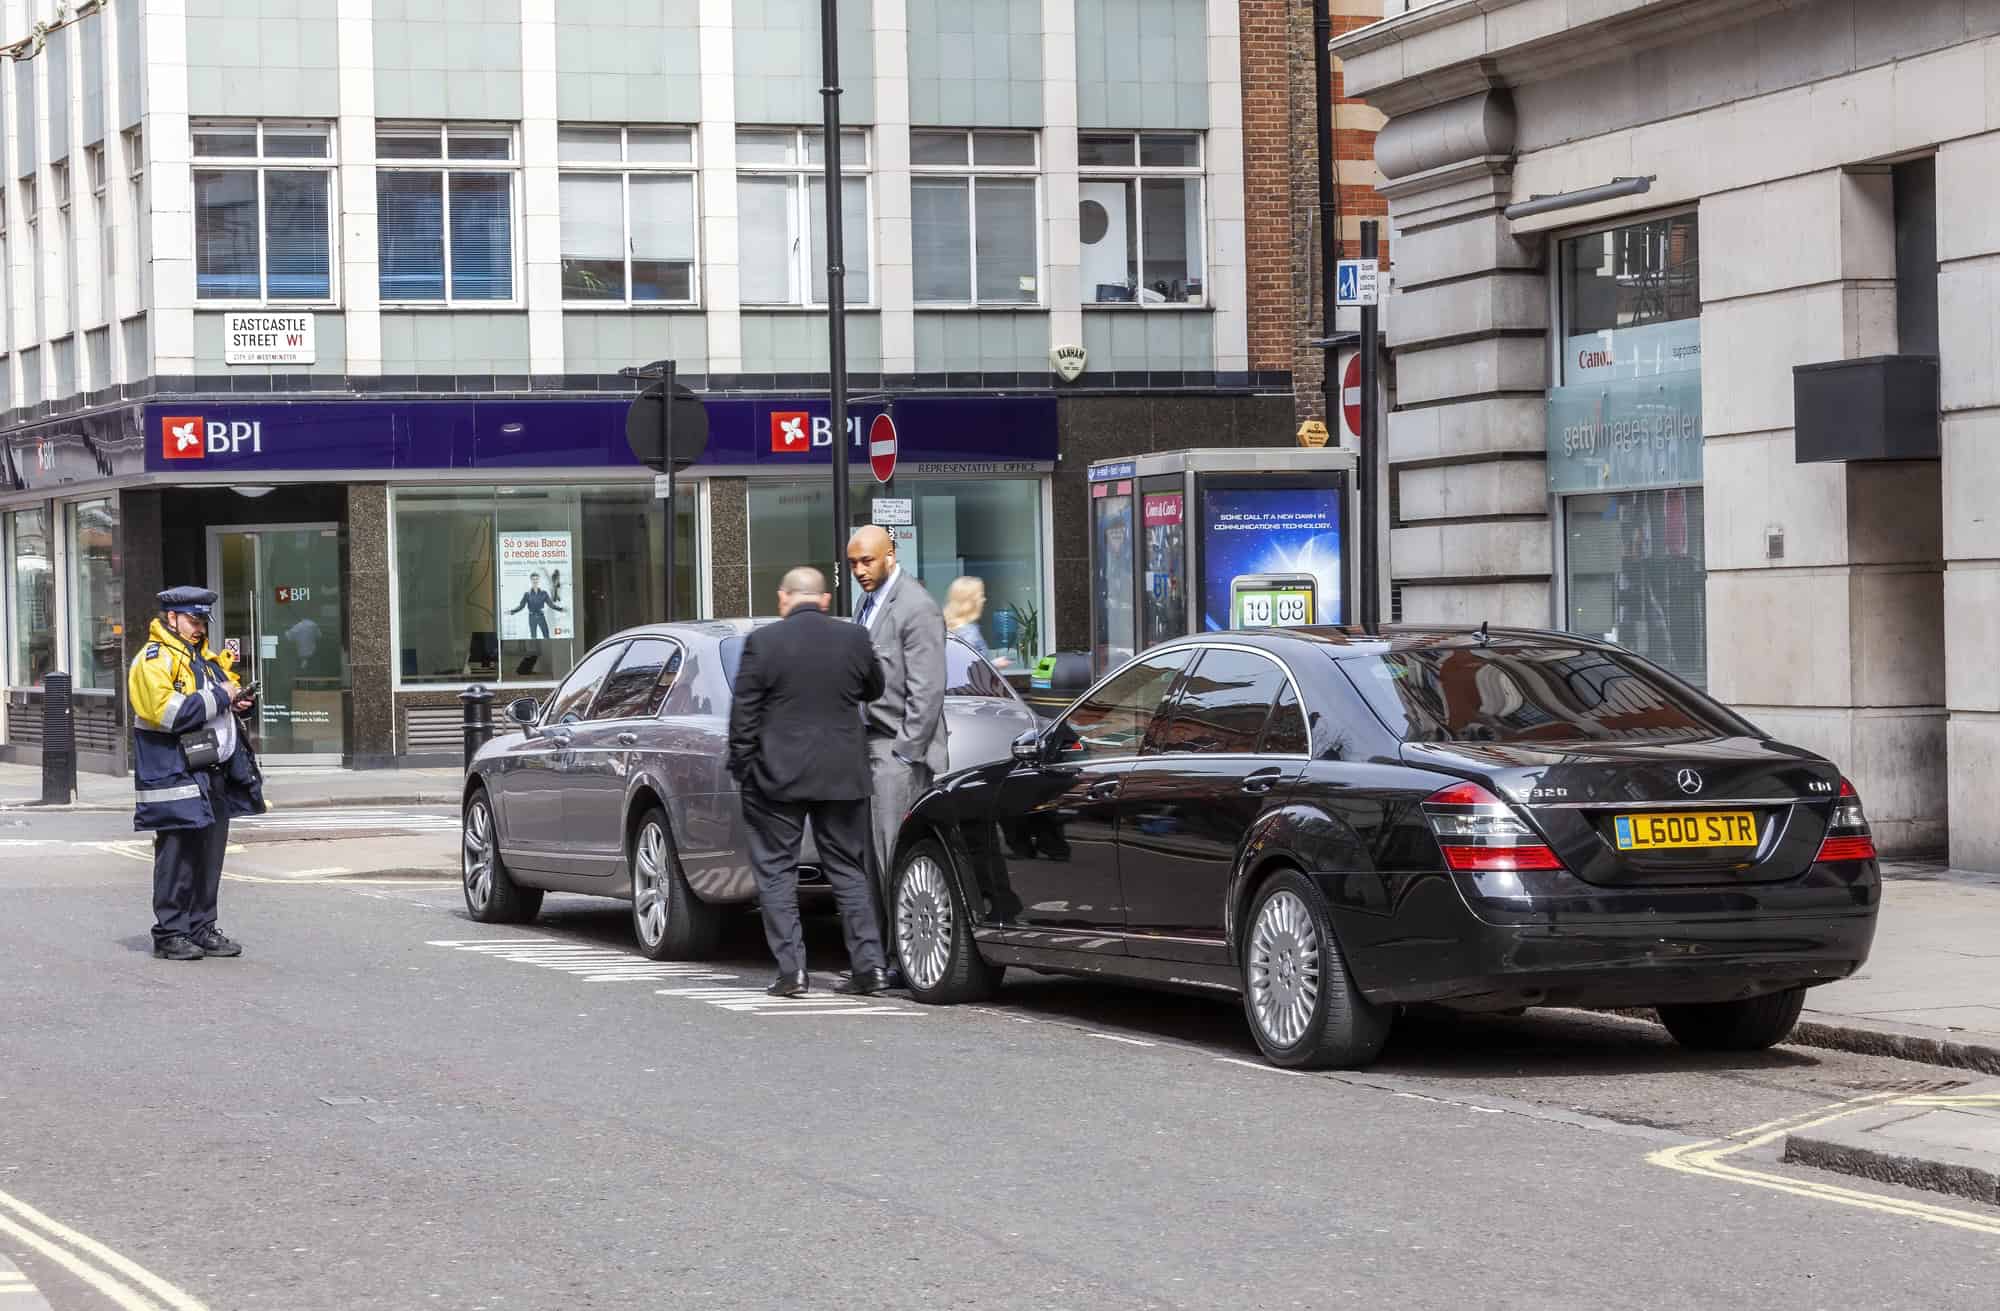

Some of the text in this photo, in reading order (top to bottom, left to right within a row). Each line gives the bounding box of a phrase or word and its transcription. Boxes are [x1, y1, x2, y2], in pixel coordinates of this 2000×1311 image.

[232, 318, 306, 331] EASTCASTLE
[233, 334, 303, 346] STREET W1
[207, 421, 262, 453] BPI
[918, 462, 1037, 473] REPRESENTATIVE OFFICE
[1220, 513, 1243, 521] SOME
[1243, 513, 1262, 521] CALL
[1214, 522, 1281, 530] COMMUNICATIONS
[524, 540, 539, 548] seu
[541, 538, 567, 548] Banco
[503, 550, 510, 559] o
[511, 549, 540, 559] recebe
[290, 587, 310, 601] BPI
[1247, 599, 1304, 621] 10 08
[1632, 815, 1752, 844] L600 STR
